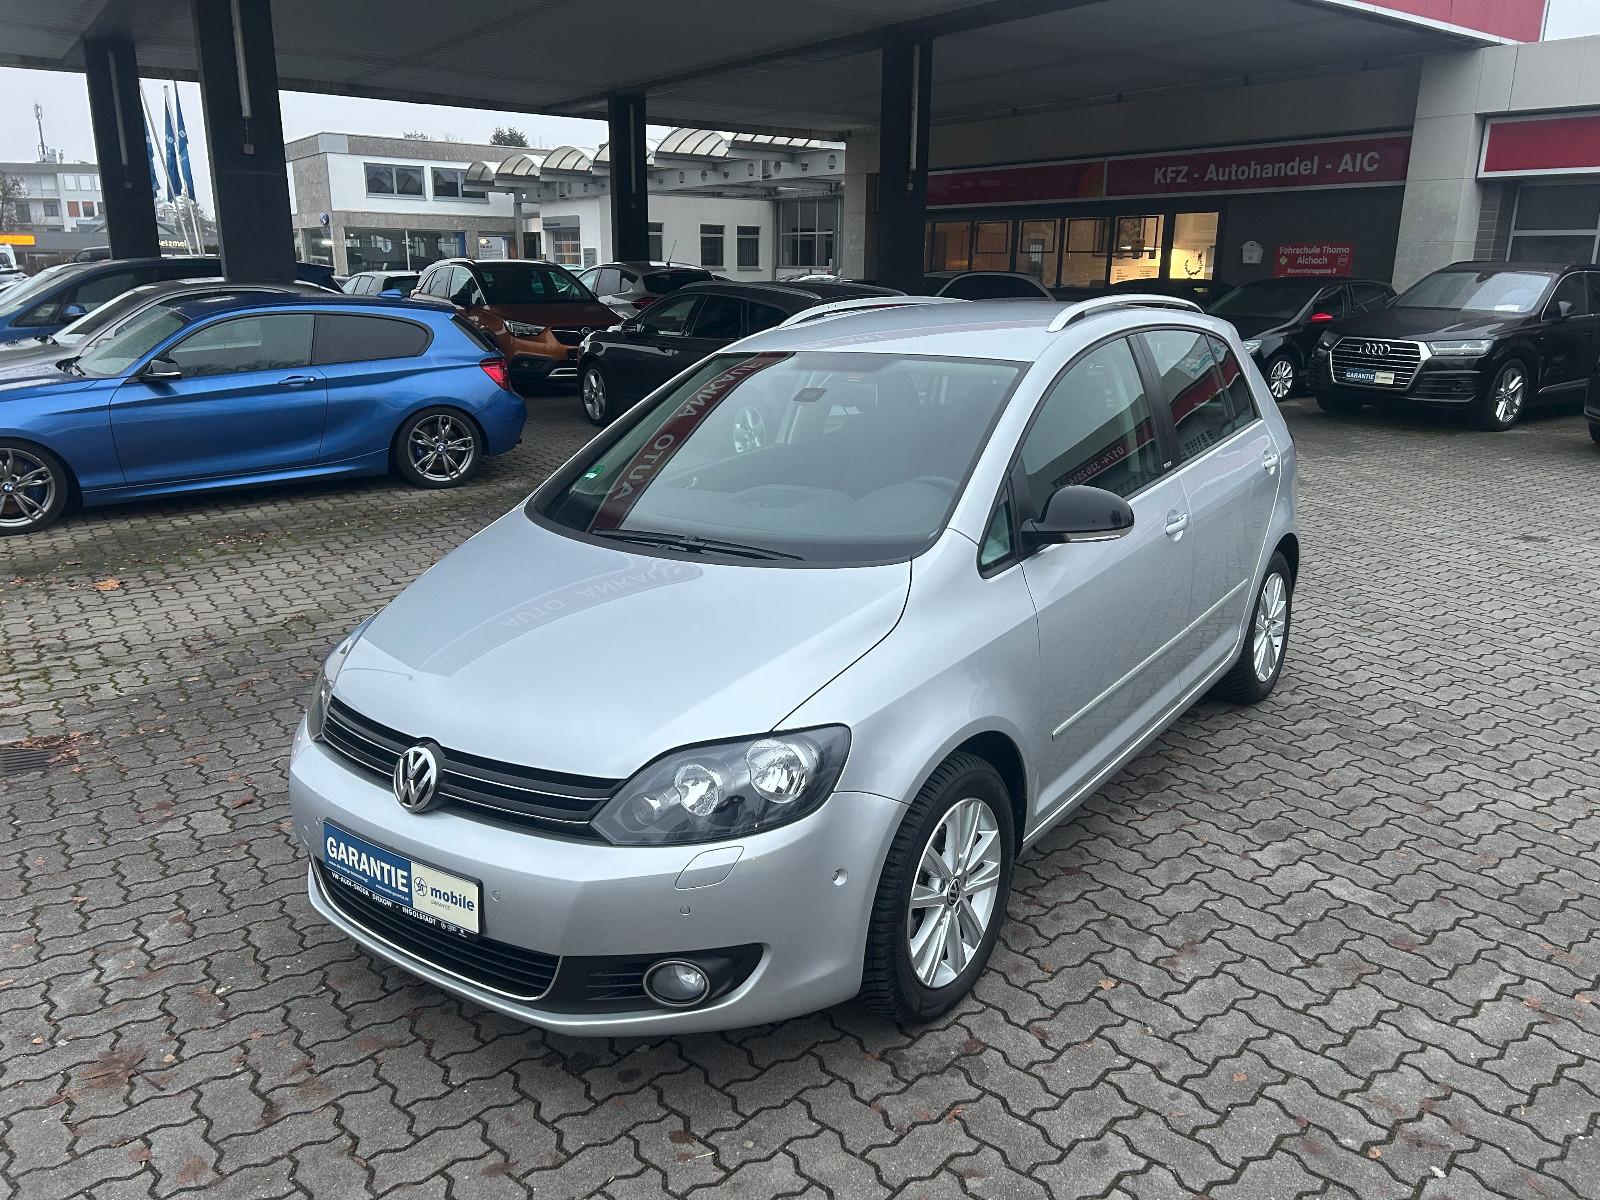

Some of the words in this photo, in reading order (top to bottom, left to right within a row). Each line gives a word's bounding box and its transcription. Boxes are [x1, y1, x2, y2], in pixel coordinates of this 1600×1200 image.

[1154, 165, 1189, 184] KFZ
[1204, 155, 1319, 182] Autohandel
[1337, 151, 1380, 173] AIC
[1279, 245, 1320, 254] Fahrschule
[1322, 245, 1350, 254] Thoma
[1296, 256, 1328, 265] Aichach
[1346, 372, 1375, 380] GARANTIE
[326, 836, 410, 893] GARANTIE
[430, 886, 475, 912] mobile
